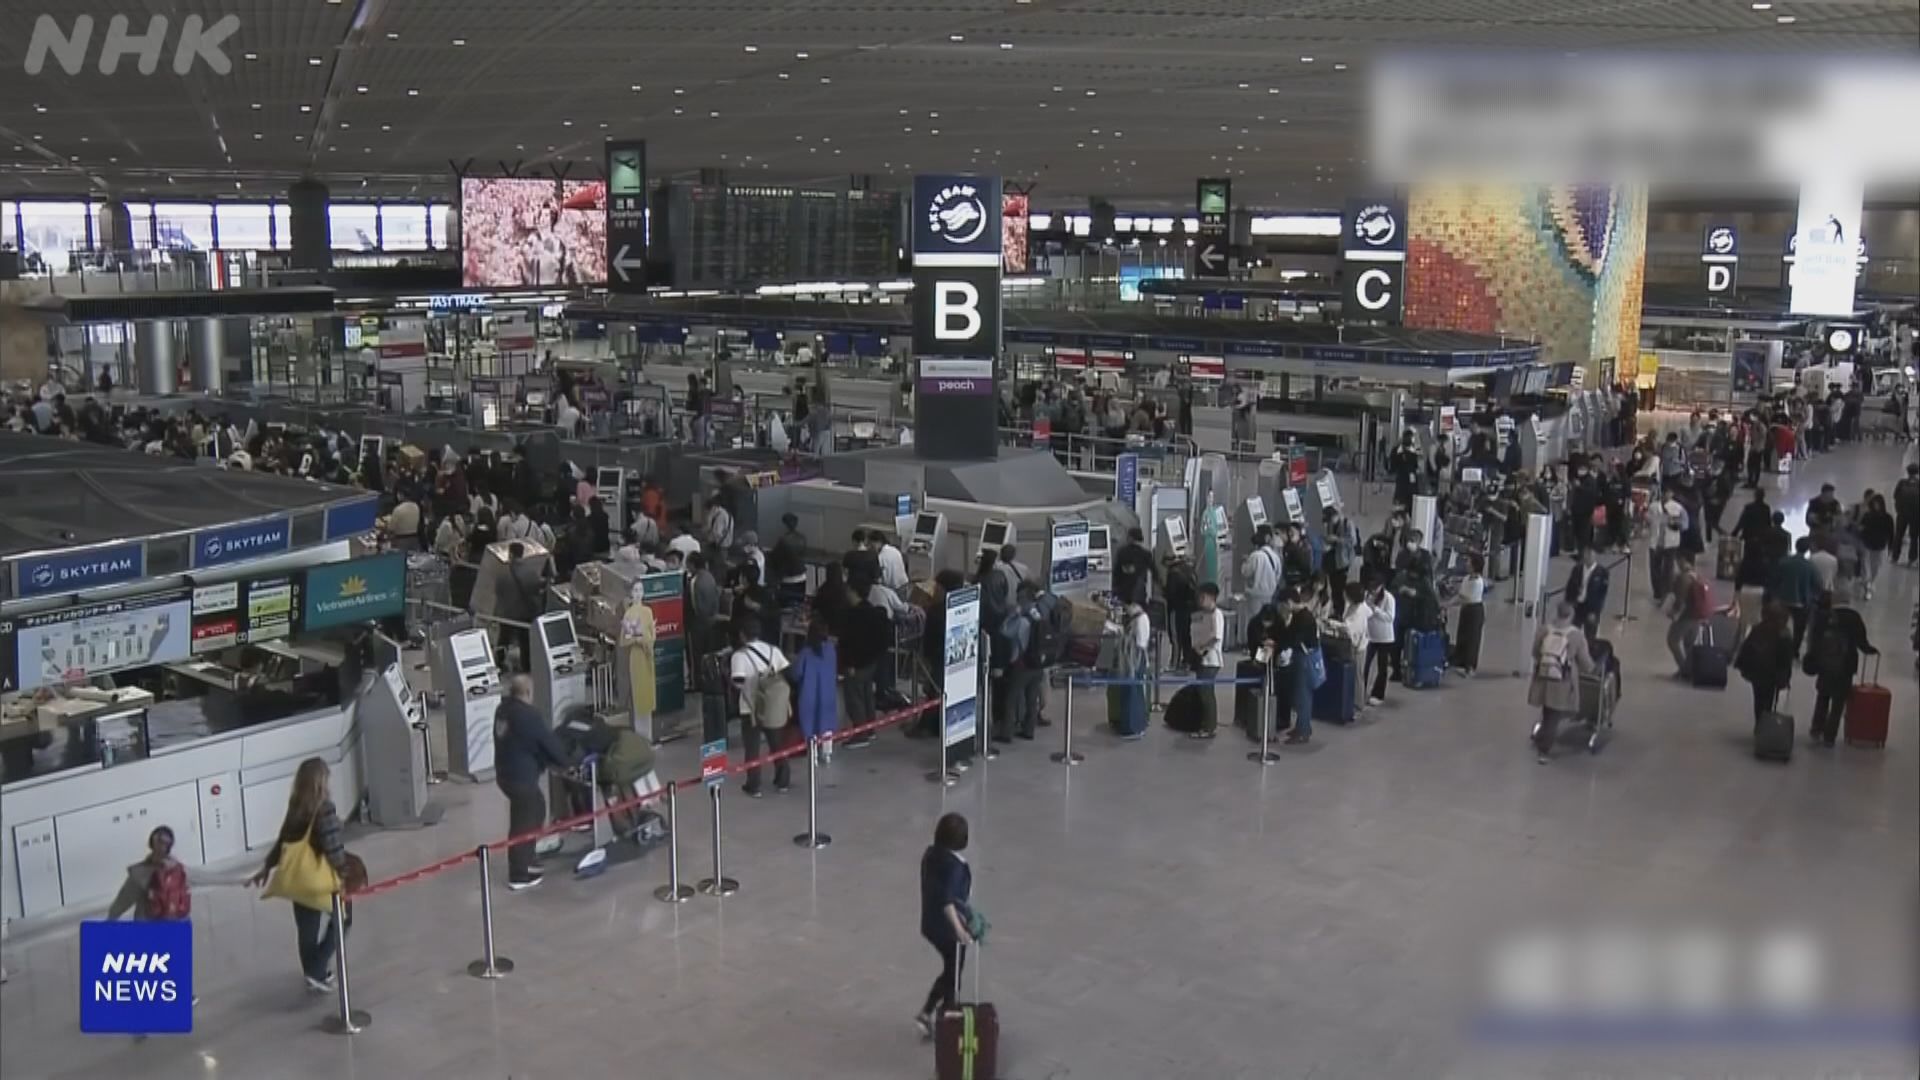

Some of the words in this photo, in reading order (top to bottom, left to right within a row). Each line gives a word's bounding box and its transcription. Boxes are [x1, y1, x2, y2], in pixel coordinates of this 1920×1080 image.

[1356, 269, 1391, 309] C
[1708, 266, 1730, 291] D
[430, 296, 451, 308] FAST
[935, 281, 981, 340] B
[938, 378, 975, 392] peach
[226, 532, 281, 551] SKYTEAM
[60, 558, 131, 580] SKYTEAM
